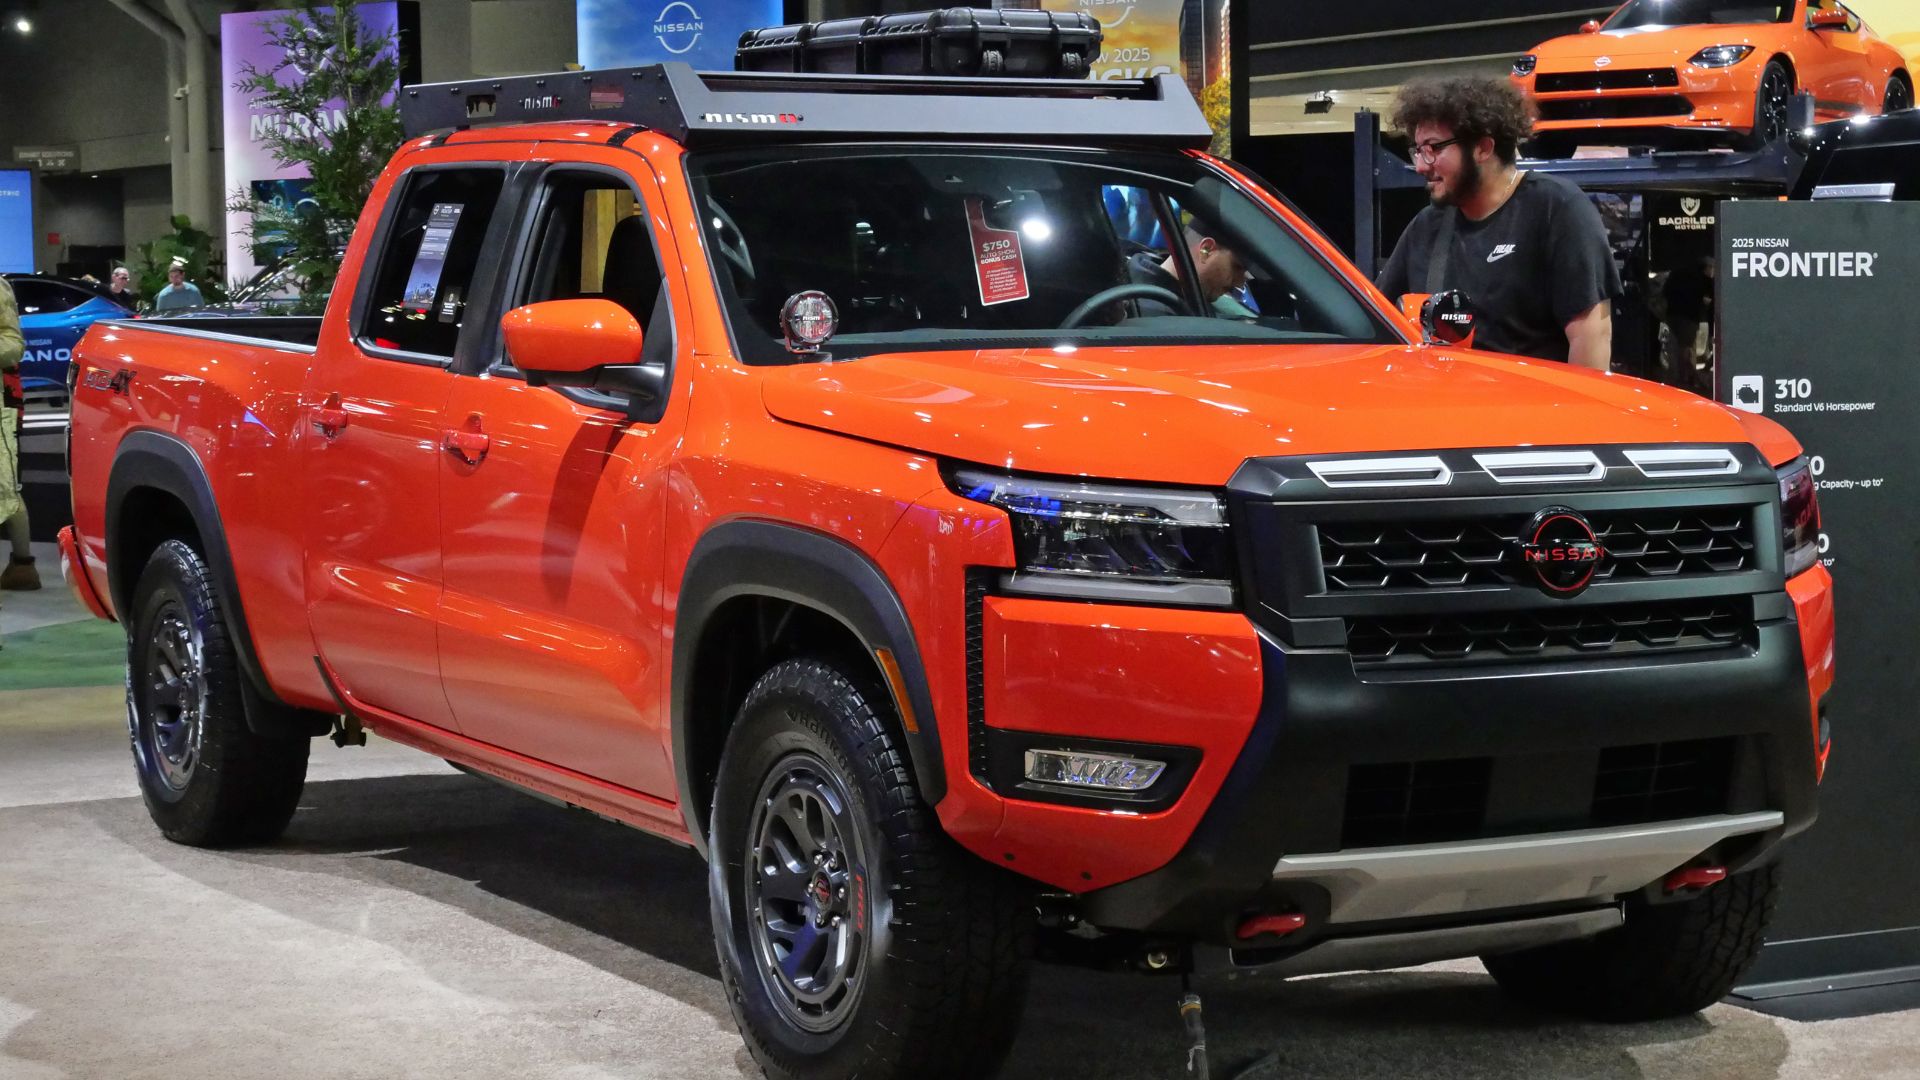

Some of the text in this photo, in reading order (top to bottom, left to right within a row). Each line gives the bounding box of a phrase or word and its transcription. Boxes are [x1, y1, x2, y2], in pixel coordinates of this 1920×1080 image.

[653, 22, 703, 33] NISSAN
[1113, 48, 1151, 62] 2025
[250, 109, 349, 141] MURAN
[982, 240, 1010, 252] $750
[1732, 238, 1789, 247] 2025 NISSAN
[1774, 378, 1812, 399] 310
[1774, 401, 1876, 412] Standard V6 Horsepower
[1820, 480, 1855, 490] Capacity
[1860, 480, 1871, 488] up
[1524, 547, 1605, 561] NISSAN
